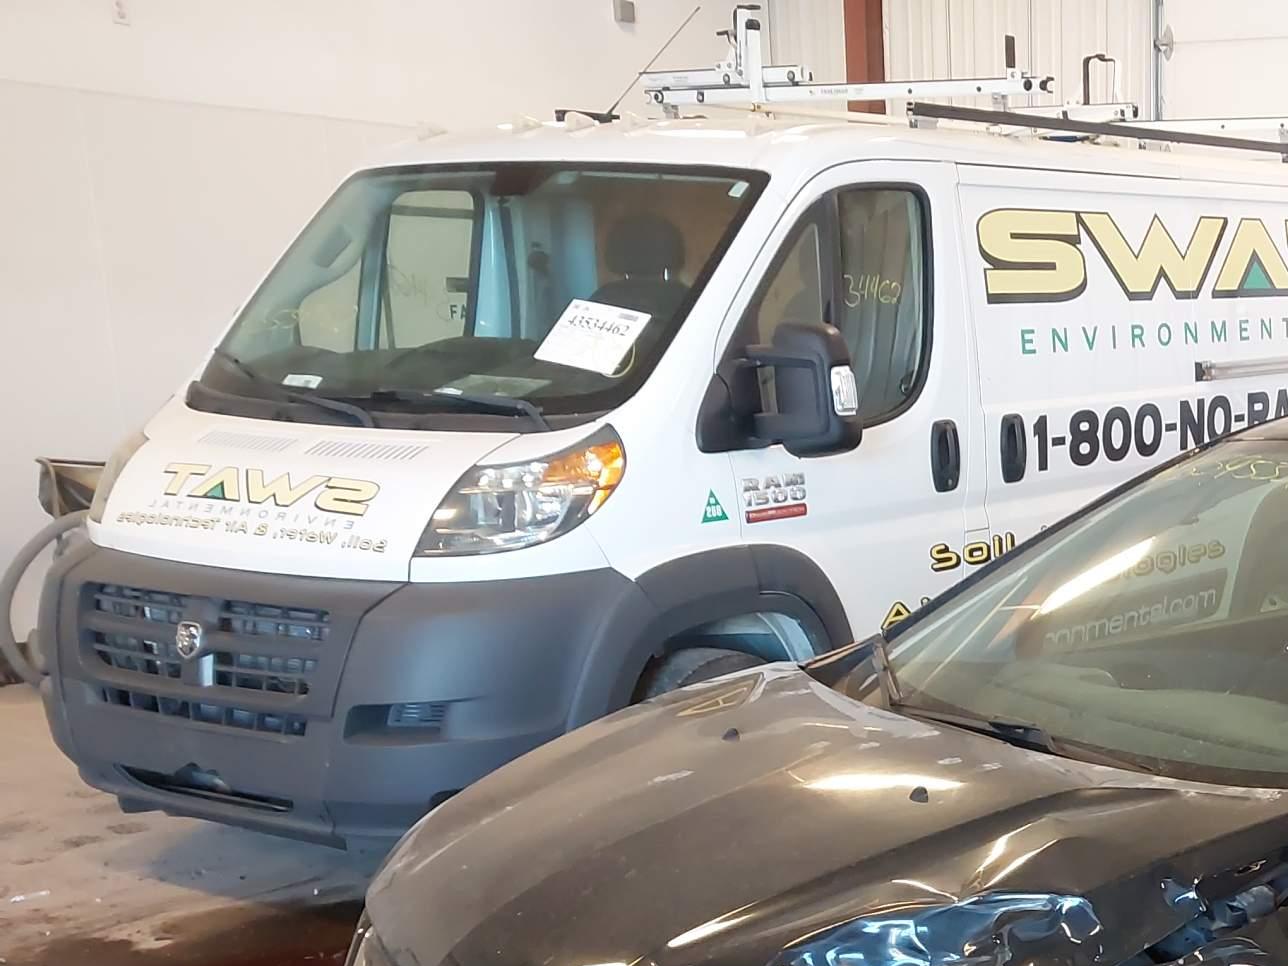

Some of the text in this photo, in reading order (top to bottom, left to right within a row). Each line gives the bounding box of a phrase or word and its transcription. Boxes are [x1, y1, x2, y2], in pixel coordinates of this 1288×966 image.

[567, 314, 630, 337] 43534462
[741, 472, 806, 492] RAM
[743, 486, 807, 507] 1500
